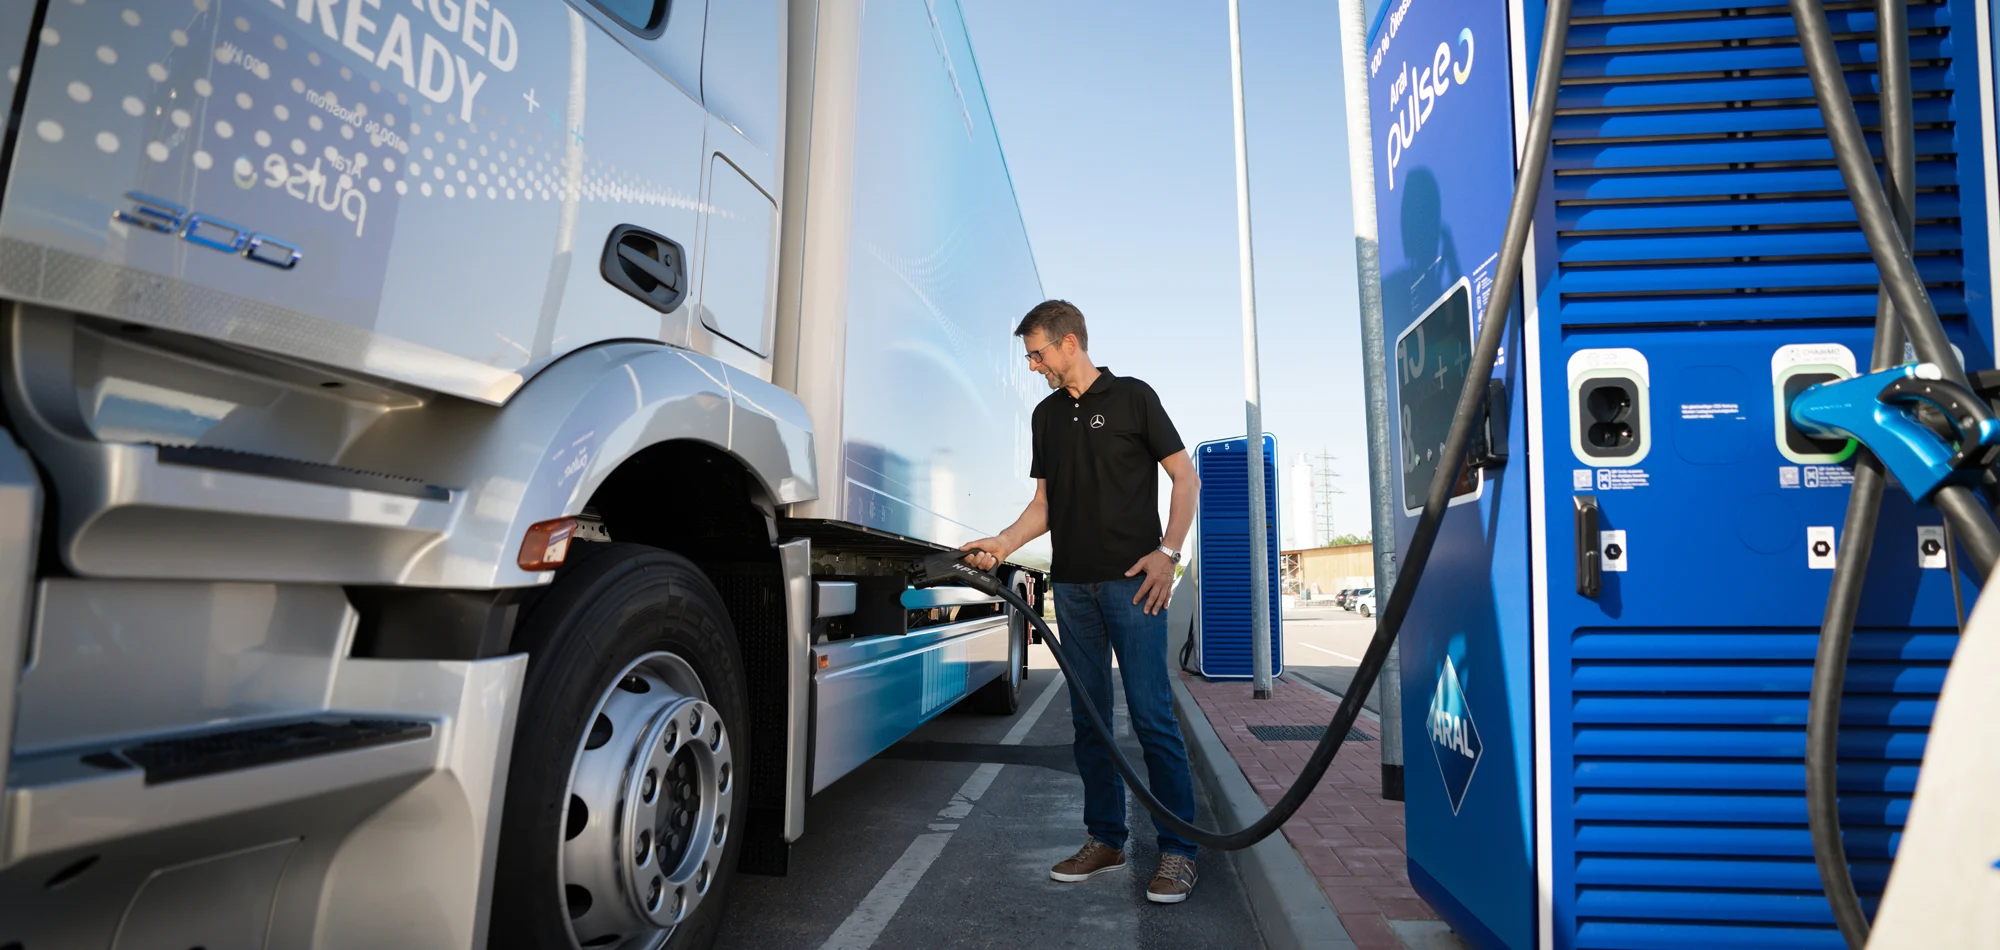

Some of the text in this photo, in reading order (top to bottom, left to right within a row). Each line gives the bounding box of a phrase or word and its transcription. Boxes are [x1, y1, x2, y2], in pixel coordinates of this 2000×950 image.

[1371, 47, 1382, 78] 100
[1382, 33, 1390, 55] %
[1390, 61, 1408, 112] Aral
[1387, 42, 1451, 191] pulse
[952, 563, 979, 576] HPC
[1432, 708, 1475, 759] ARAL
